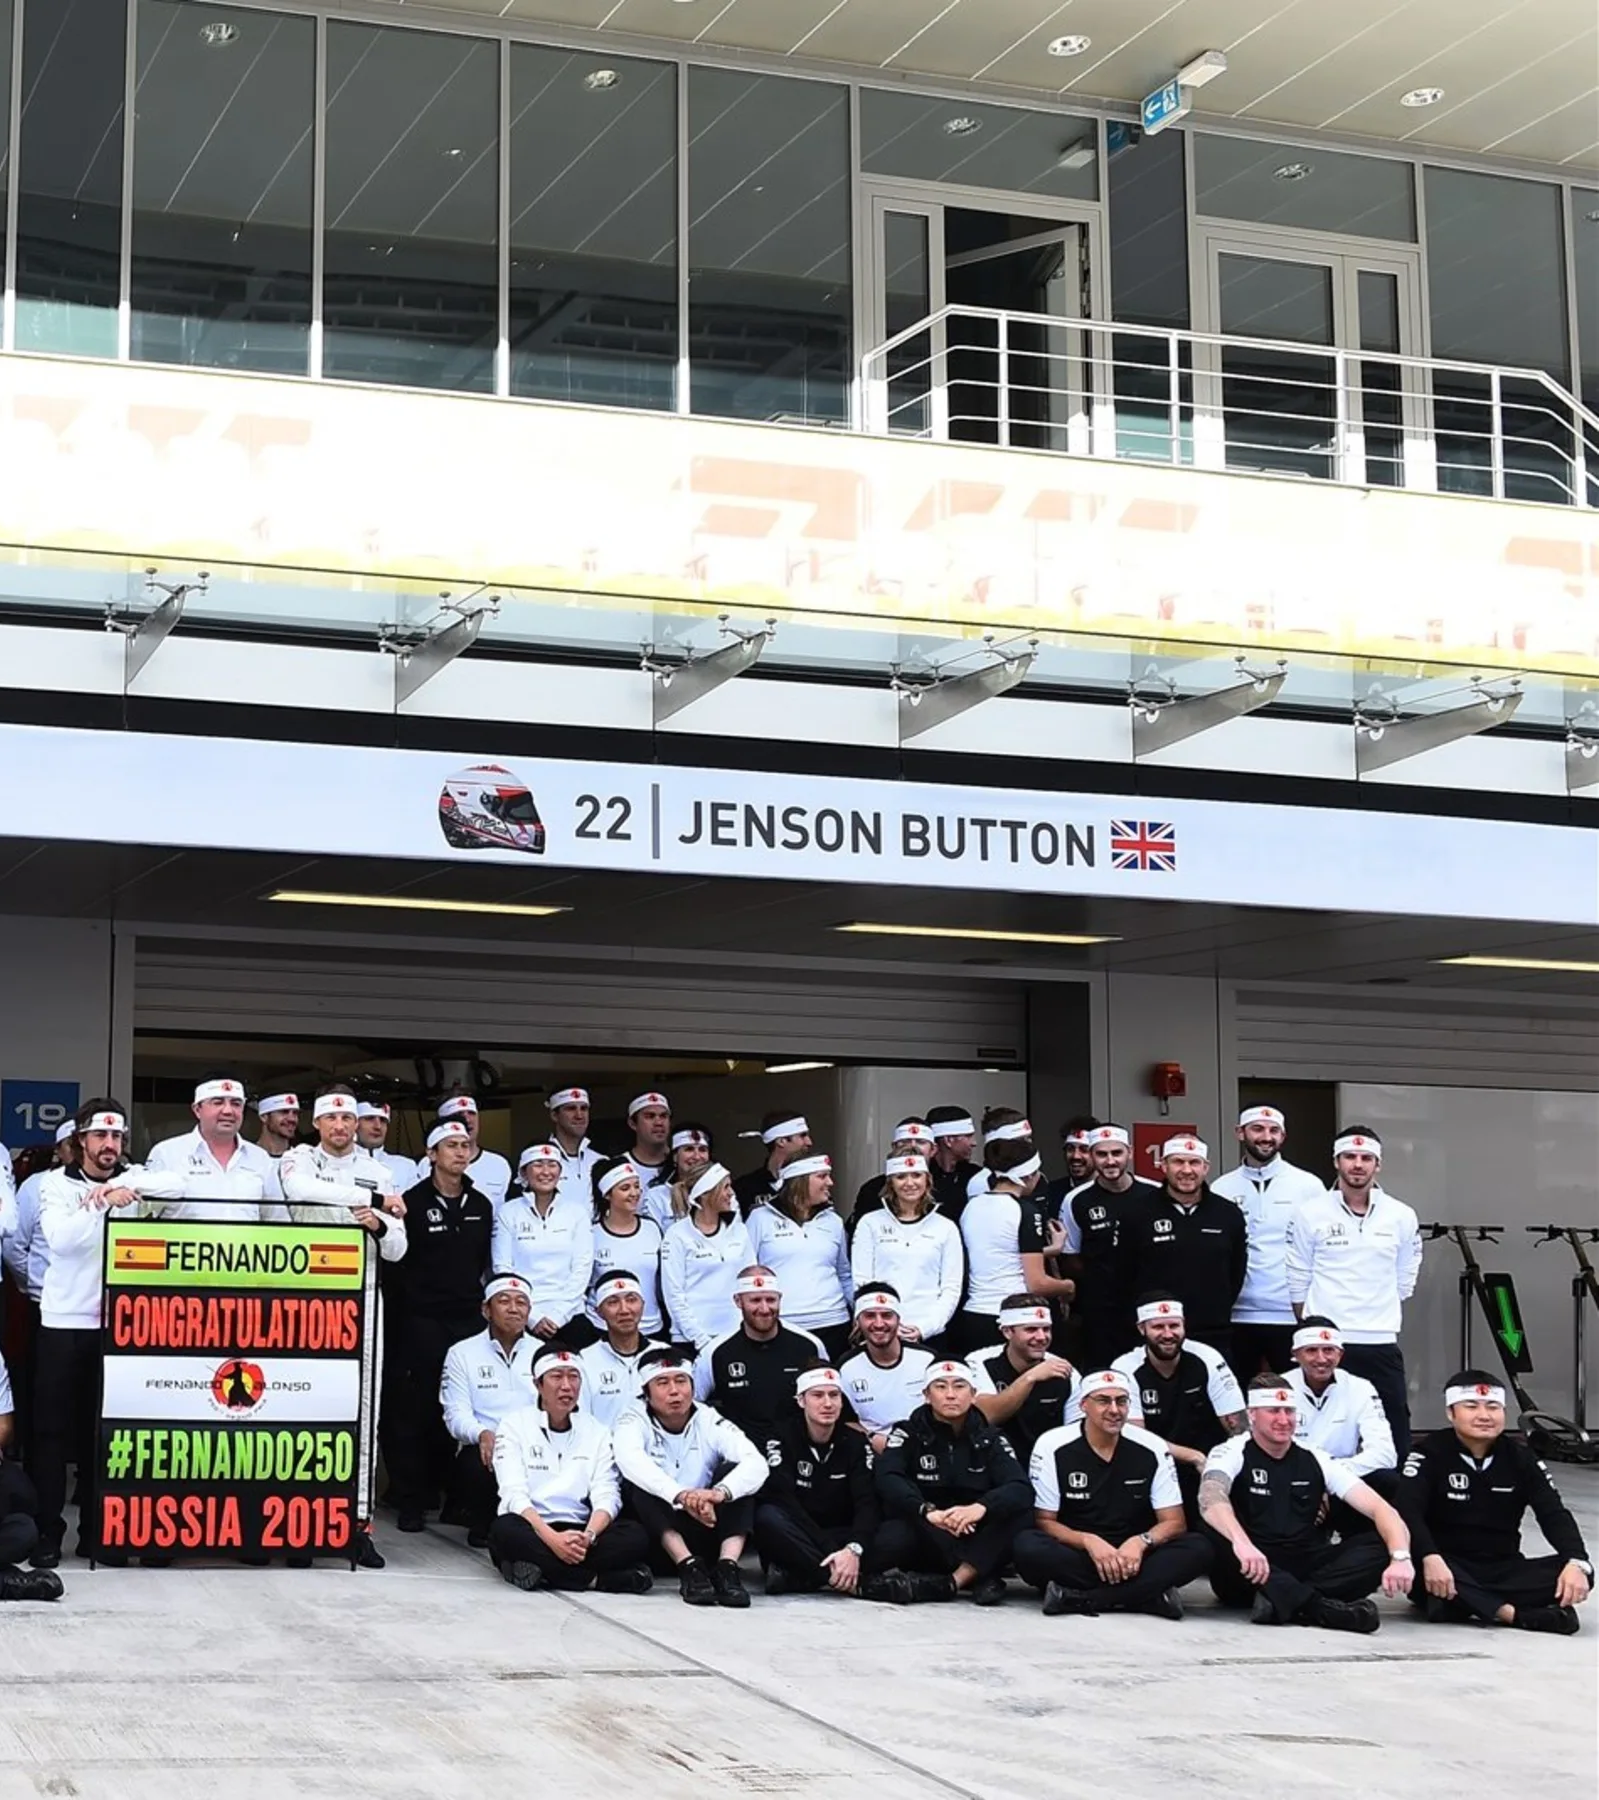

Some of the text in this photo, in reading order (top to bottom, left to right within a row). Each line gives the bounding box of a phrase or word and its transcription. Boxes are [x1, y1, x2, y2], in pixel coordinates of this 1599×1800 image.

[575, 794, 1095, 868] 22 JENSON BUTTON
[14, 1103, 66, 1130] 19
[165, 1241, 310, 1275] FERNANDO
[114, 1294, 359, 1350] CONGRATULATIONS
[106, 1429, 353, 1482] #FERNANDO250
[102, 1495, 350, 1548] RUSSIA 2015
